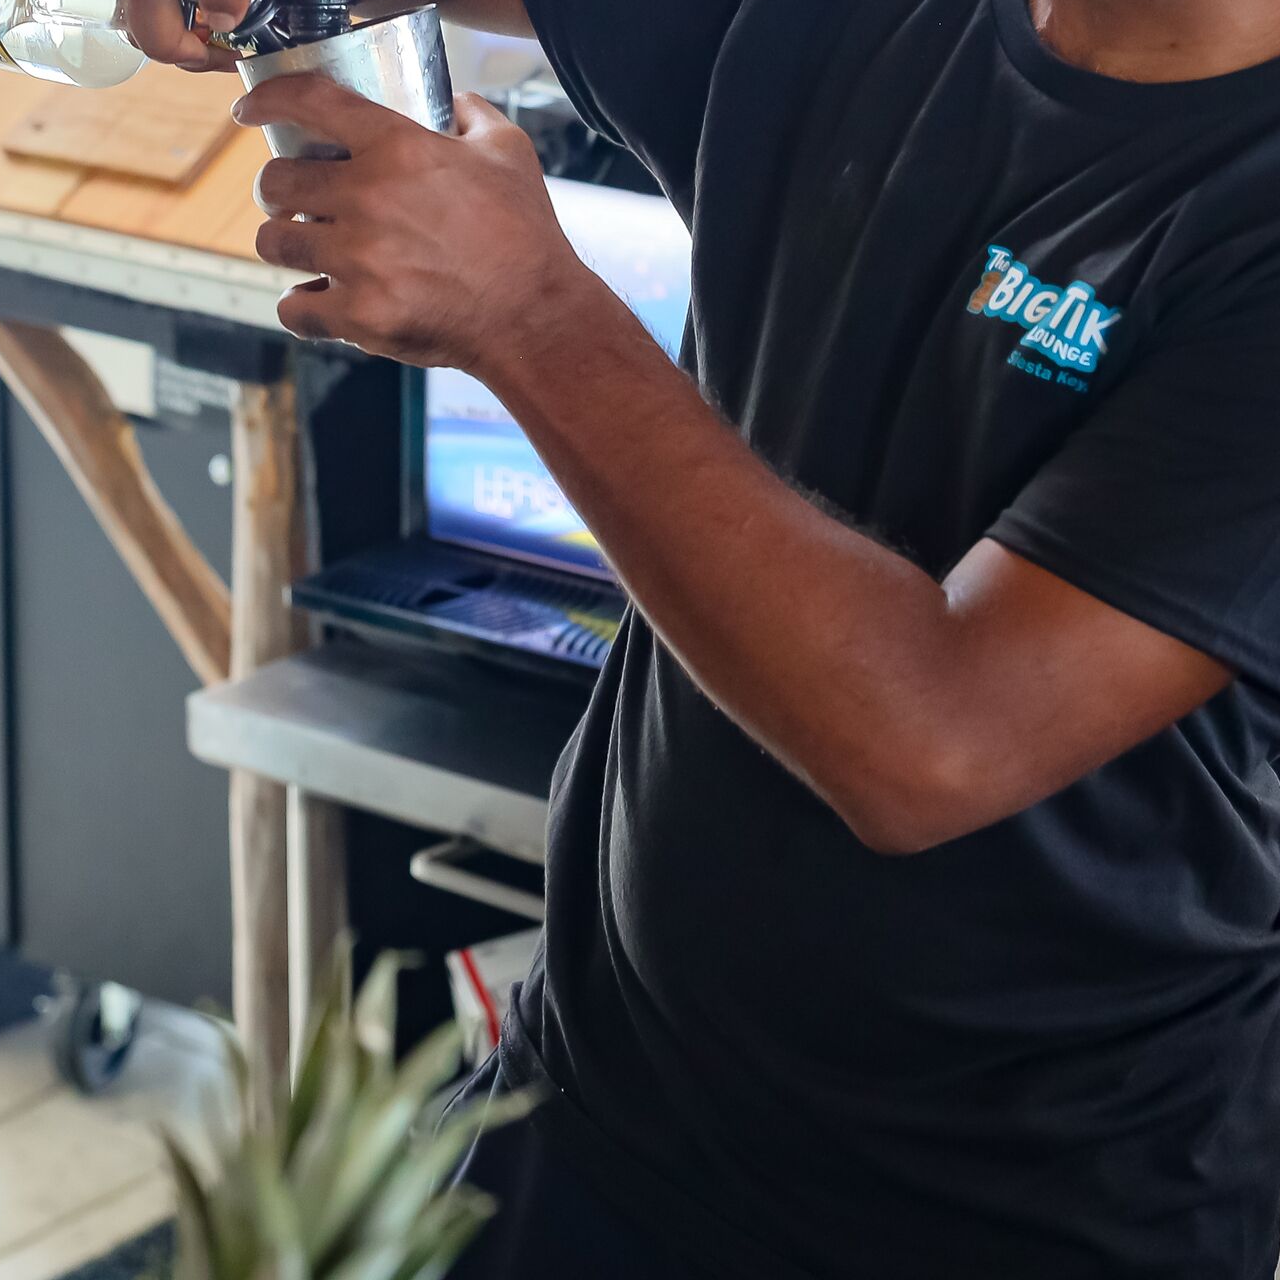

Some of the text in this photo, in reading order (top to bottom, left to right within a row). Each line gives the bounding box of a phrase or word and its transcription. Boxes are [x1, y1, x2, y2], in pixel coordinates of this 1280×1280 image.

[990, 249, 1010, 270] The
[1026, 325, 1093, 367] LOUNGE
[1007, 350, 1052, 381] Siesta
